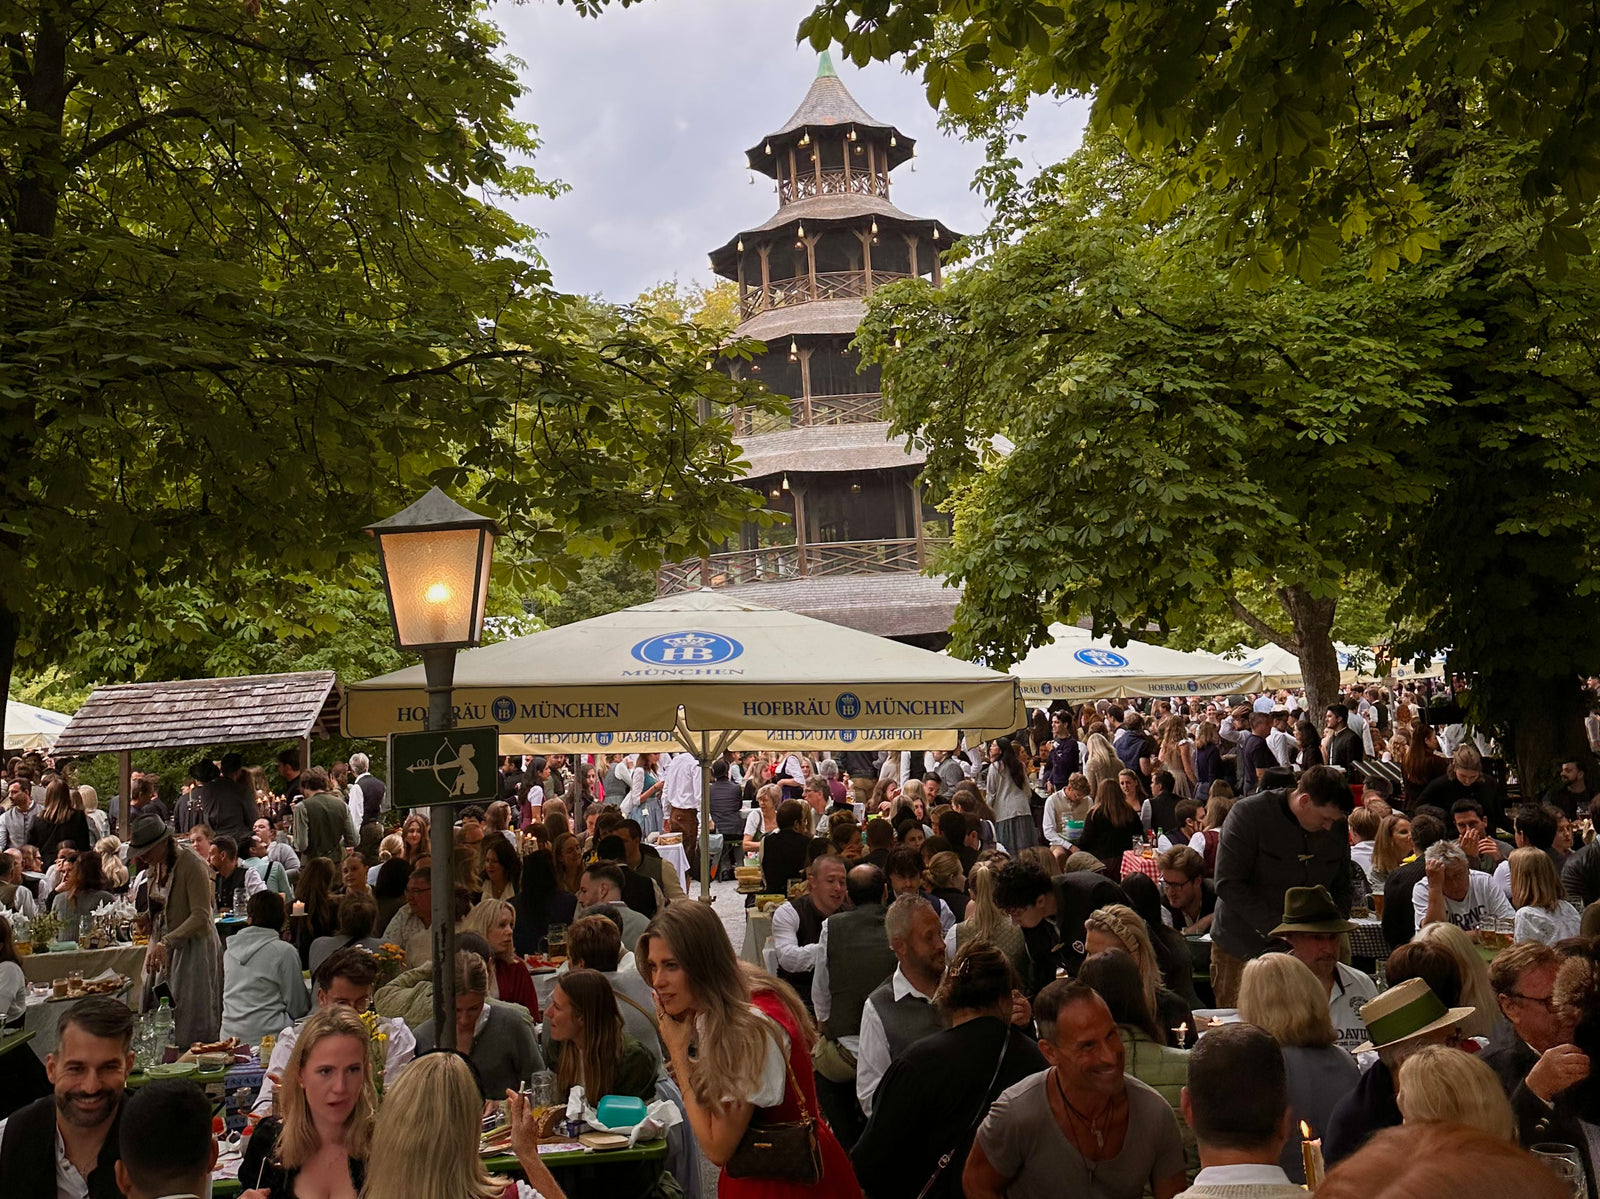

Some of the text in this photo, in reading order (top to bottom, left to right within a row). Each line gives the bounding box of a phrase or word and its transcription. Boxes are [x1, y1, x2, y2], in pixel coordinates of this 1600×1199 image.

[660, 647, 714, 662] HB
[622, 666, 744, 676] MÜNCHEN
[1053, 684, 1096, 694] MÜNCHEN
[1148, 682, 1186, 691] HOFBRÄU
[397, 702, 486, 722] HORÄU
[520, 700, 620, 719] MÜNCHEN
[743, 697, 965, 716] HOFBRÄU HB MÜNCHEN
